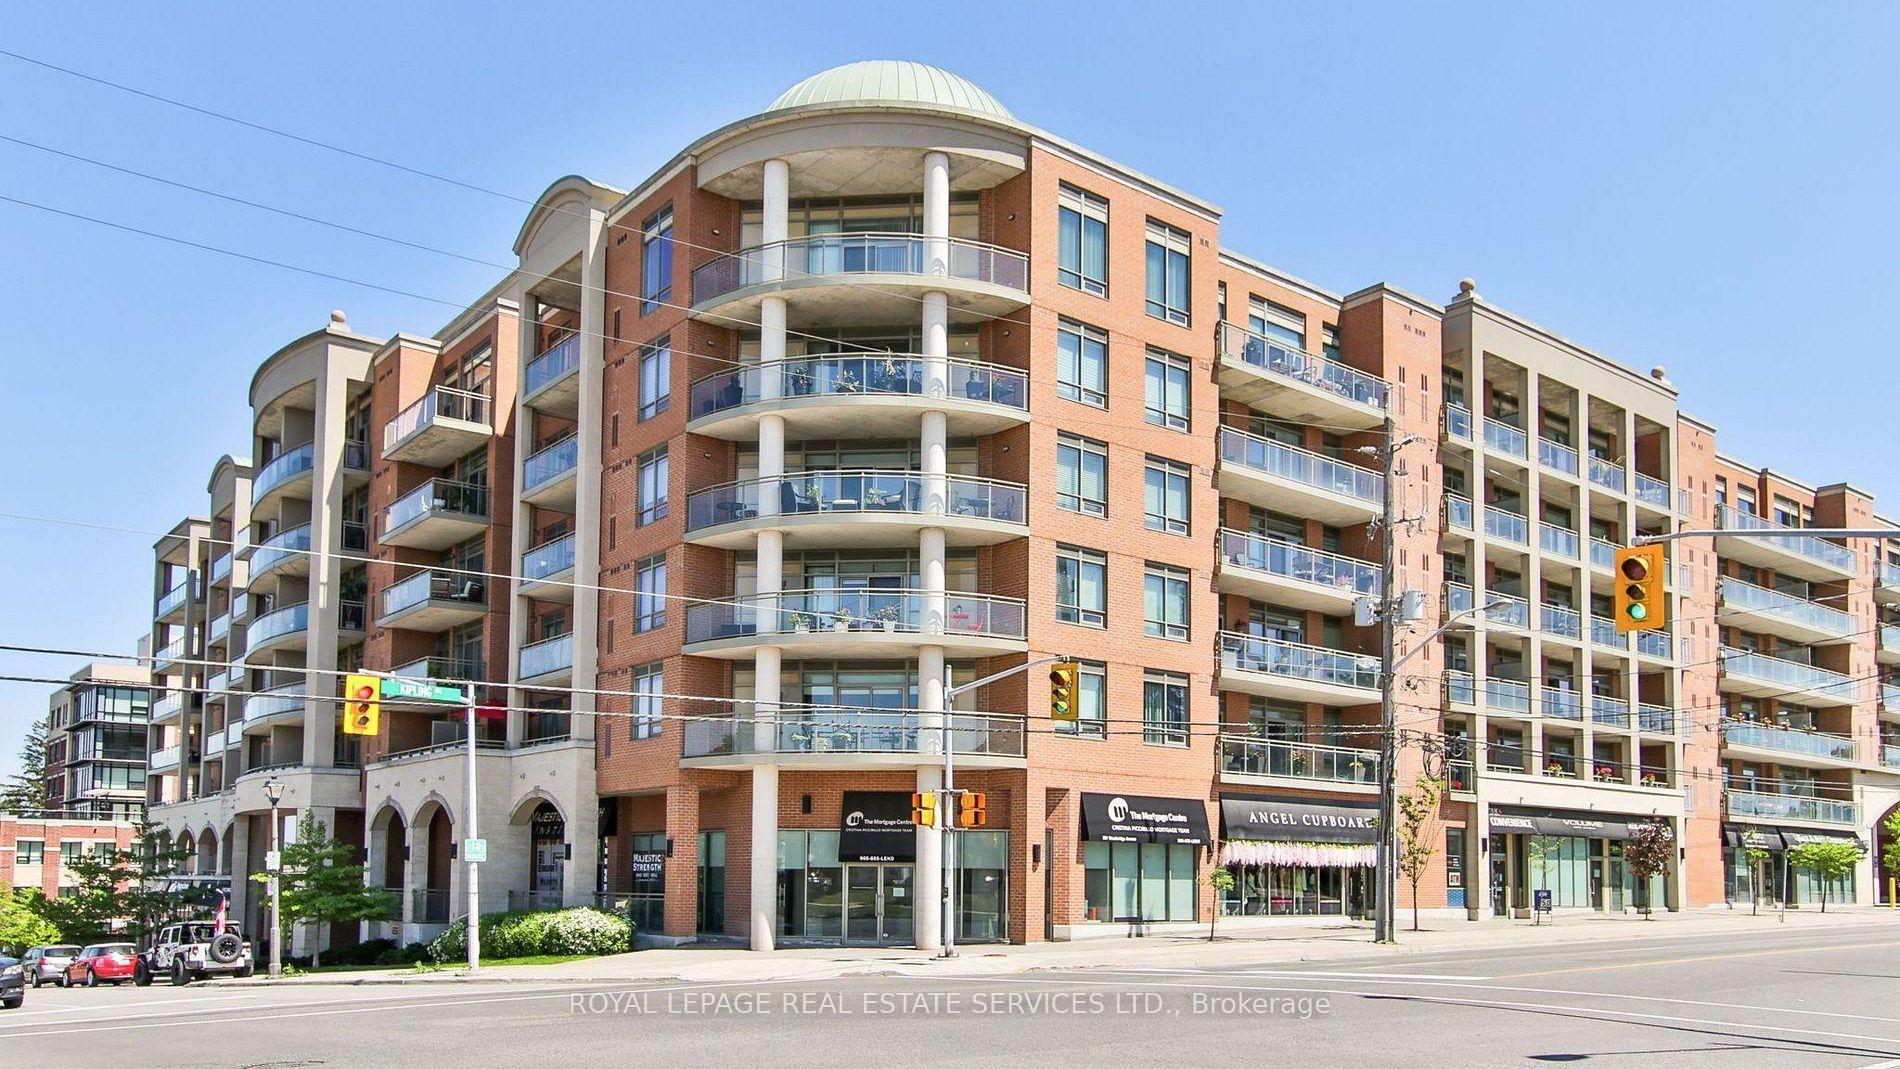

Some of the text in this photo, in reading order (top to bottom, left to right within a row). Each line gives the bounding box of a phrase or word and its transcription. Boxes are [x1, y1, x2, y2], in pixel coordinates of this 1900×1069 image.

[401, 684, 431, 697] KIPLING
[873, 818, 897, 826] Mortgage
[1129, 810, 1188, 823] The Mortgage Centre
[1249, 811, 1298, 826] ANGEL
[633, 853, 662, 863] MAJESTIC
[633, 862, 662, 872] STRENGTH
